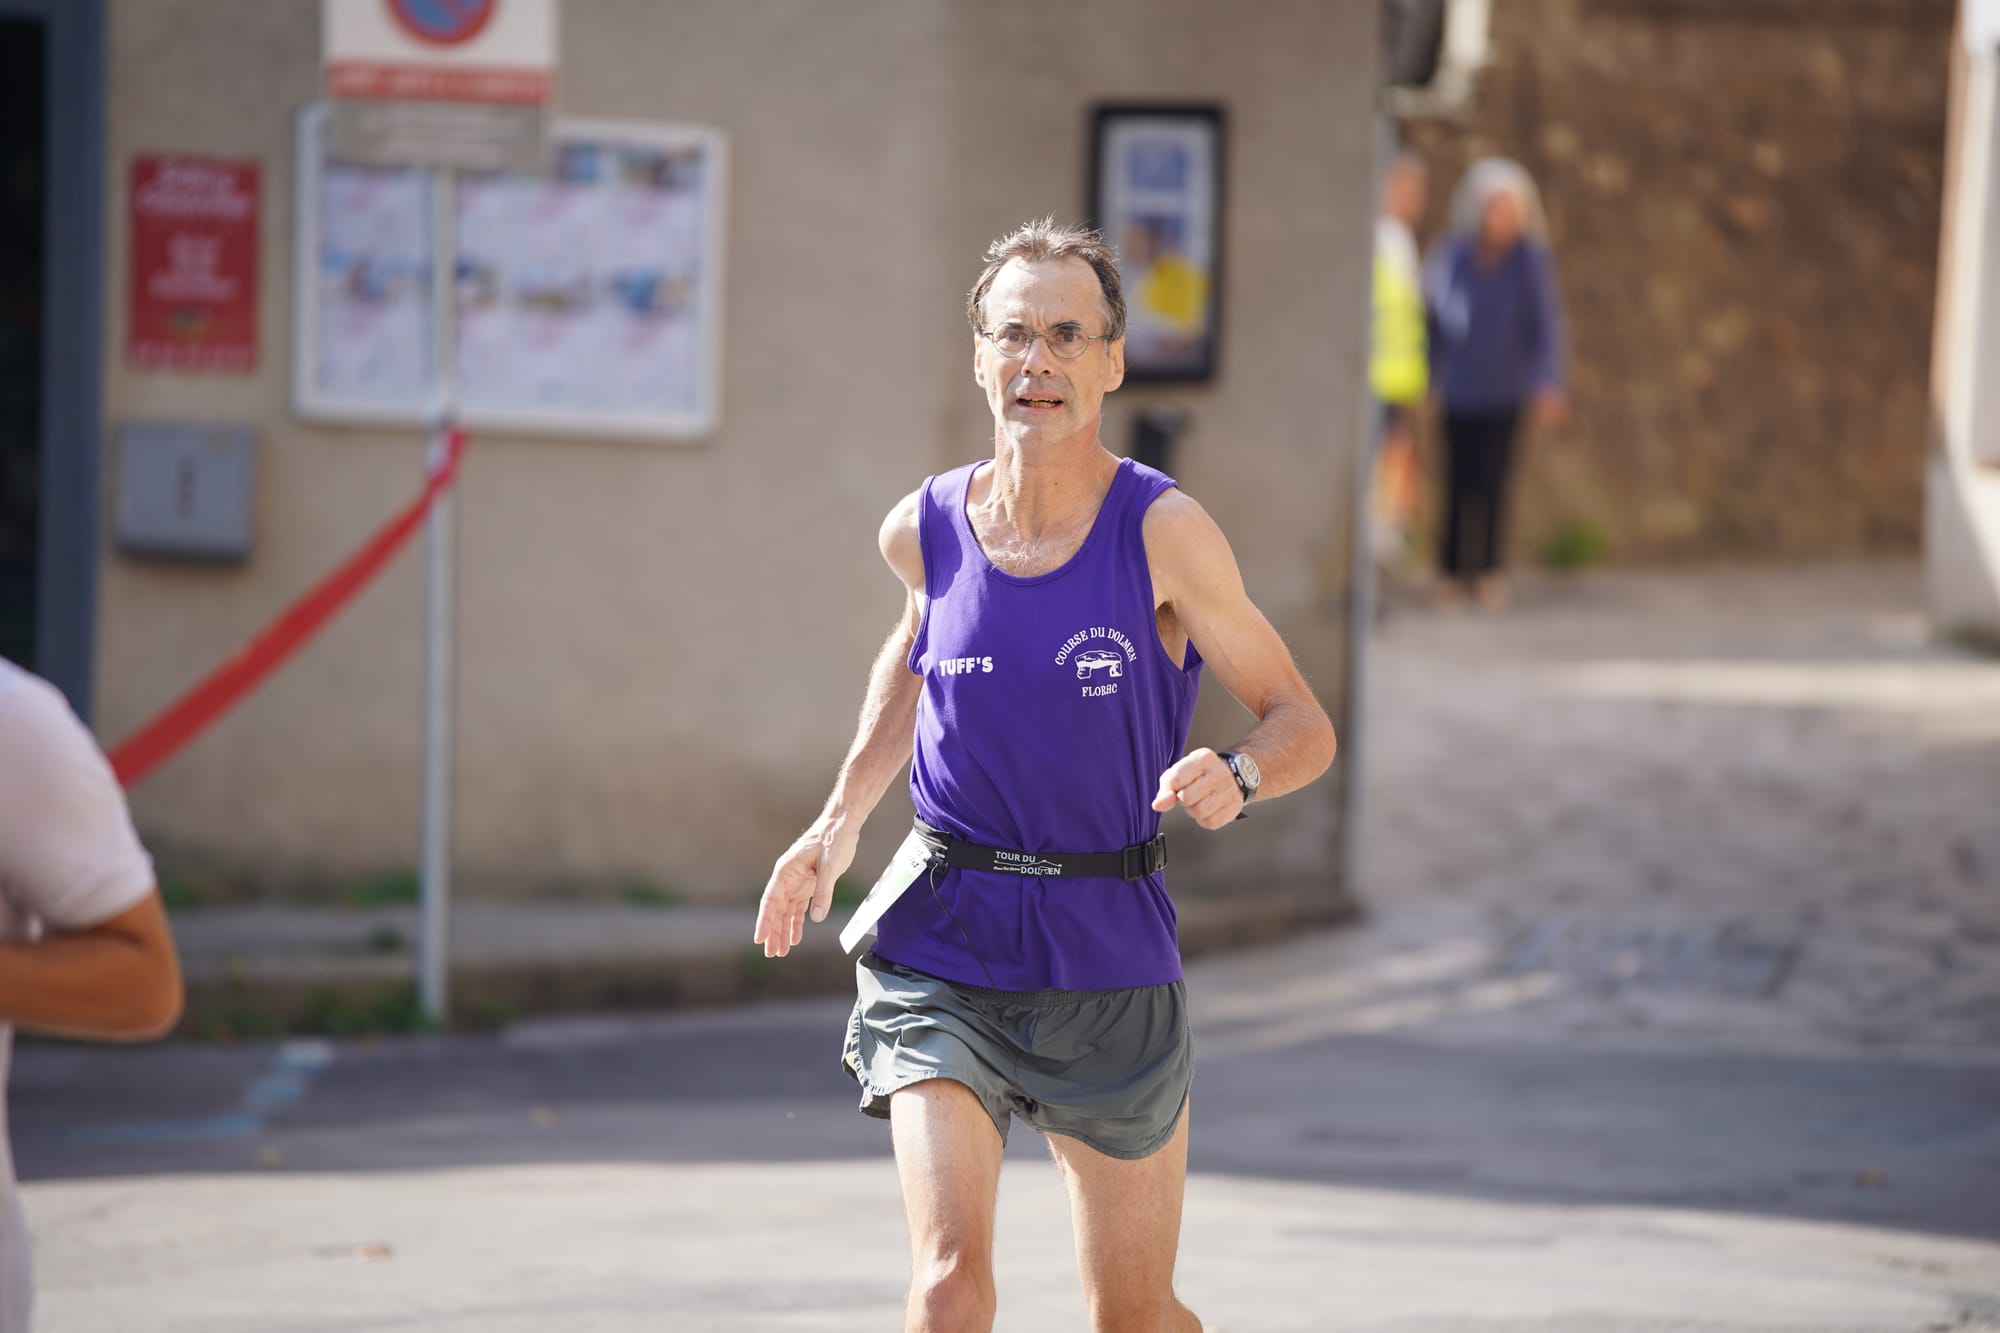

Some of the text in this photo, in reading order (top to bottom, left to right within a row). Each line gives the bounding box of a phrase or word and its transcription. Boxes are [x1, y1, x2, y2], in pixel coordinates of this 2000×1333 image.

[1055, 627, 1137, 665] COURSE DU DOLMEN
[939, 656, 994, 677] TUFF'S
[1082, 683, 1118, 697] FLORAC
[995, 850, 1036, 863] TOUR DU
